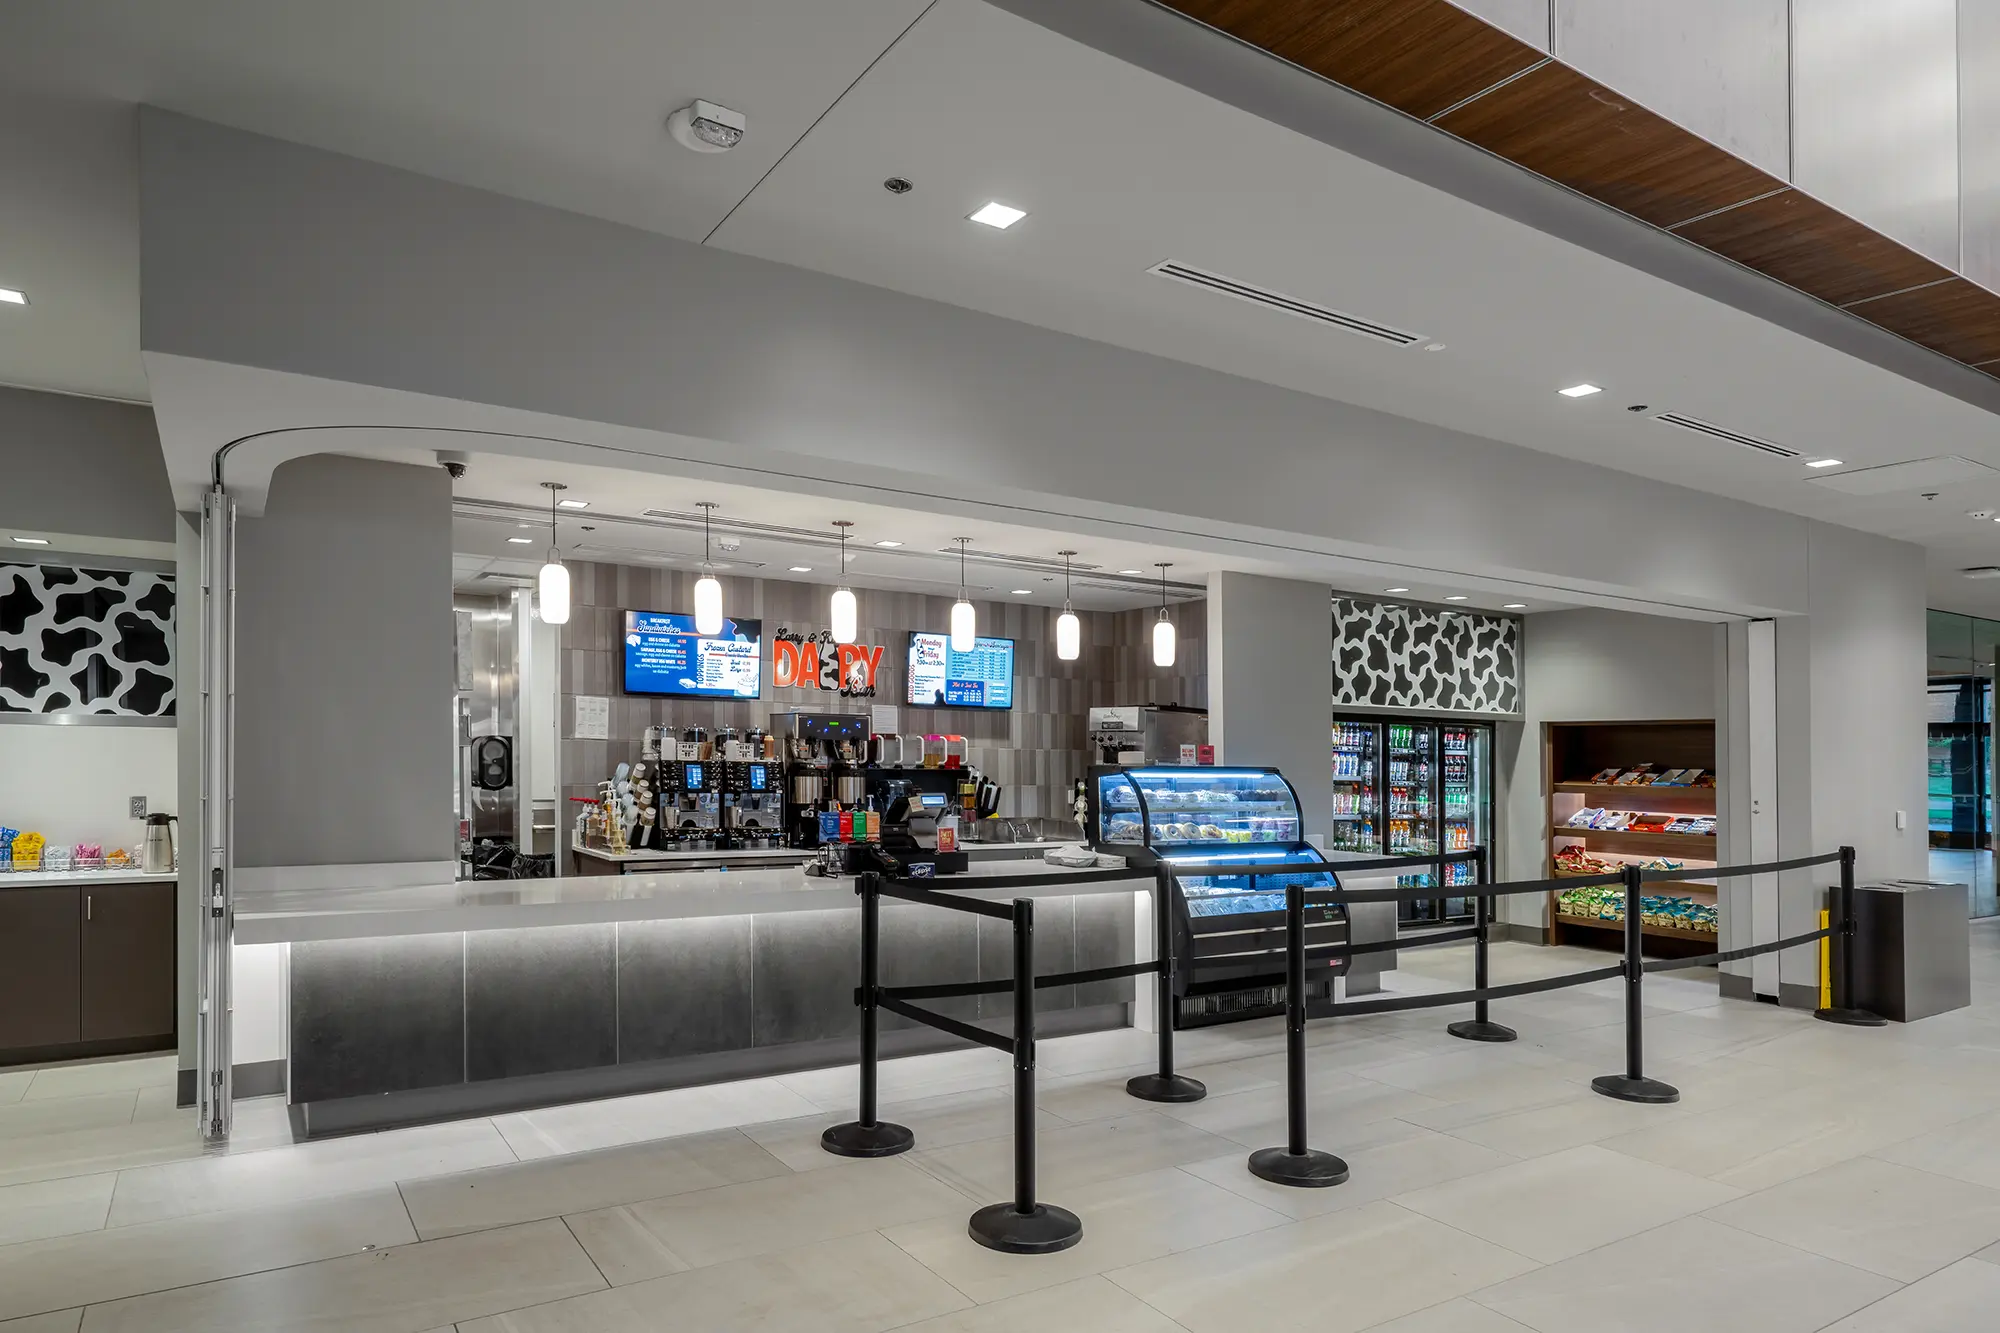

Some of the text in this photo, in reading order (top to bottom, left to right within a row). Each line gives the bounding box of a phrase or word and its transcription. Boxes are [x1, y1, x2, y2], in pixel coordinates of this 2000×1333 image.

[637, 620, 681, 635] Sandwiches
[774, 627, 804, 645] Larry
[807, 632, 818, 643] &
[921, 638, 942, 648] Monday
[704, 642, 752, 653] Frozen Custard
[923, 650, 940, 659] Friday
[697, 653, 705, 685] TOPPINGS
[840, 675, 876, 698] Bar
